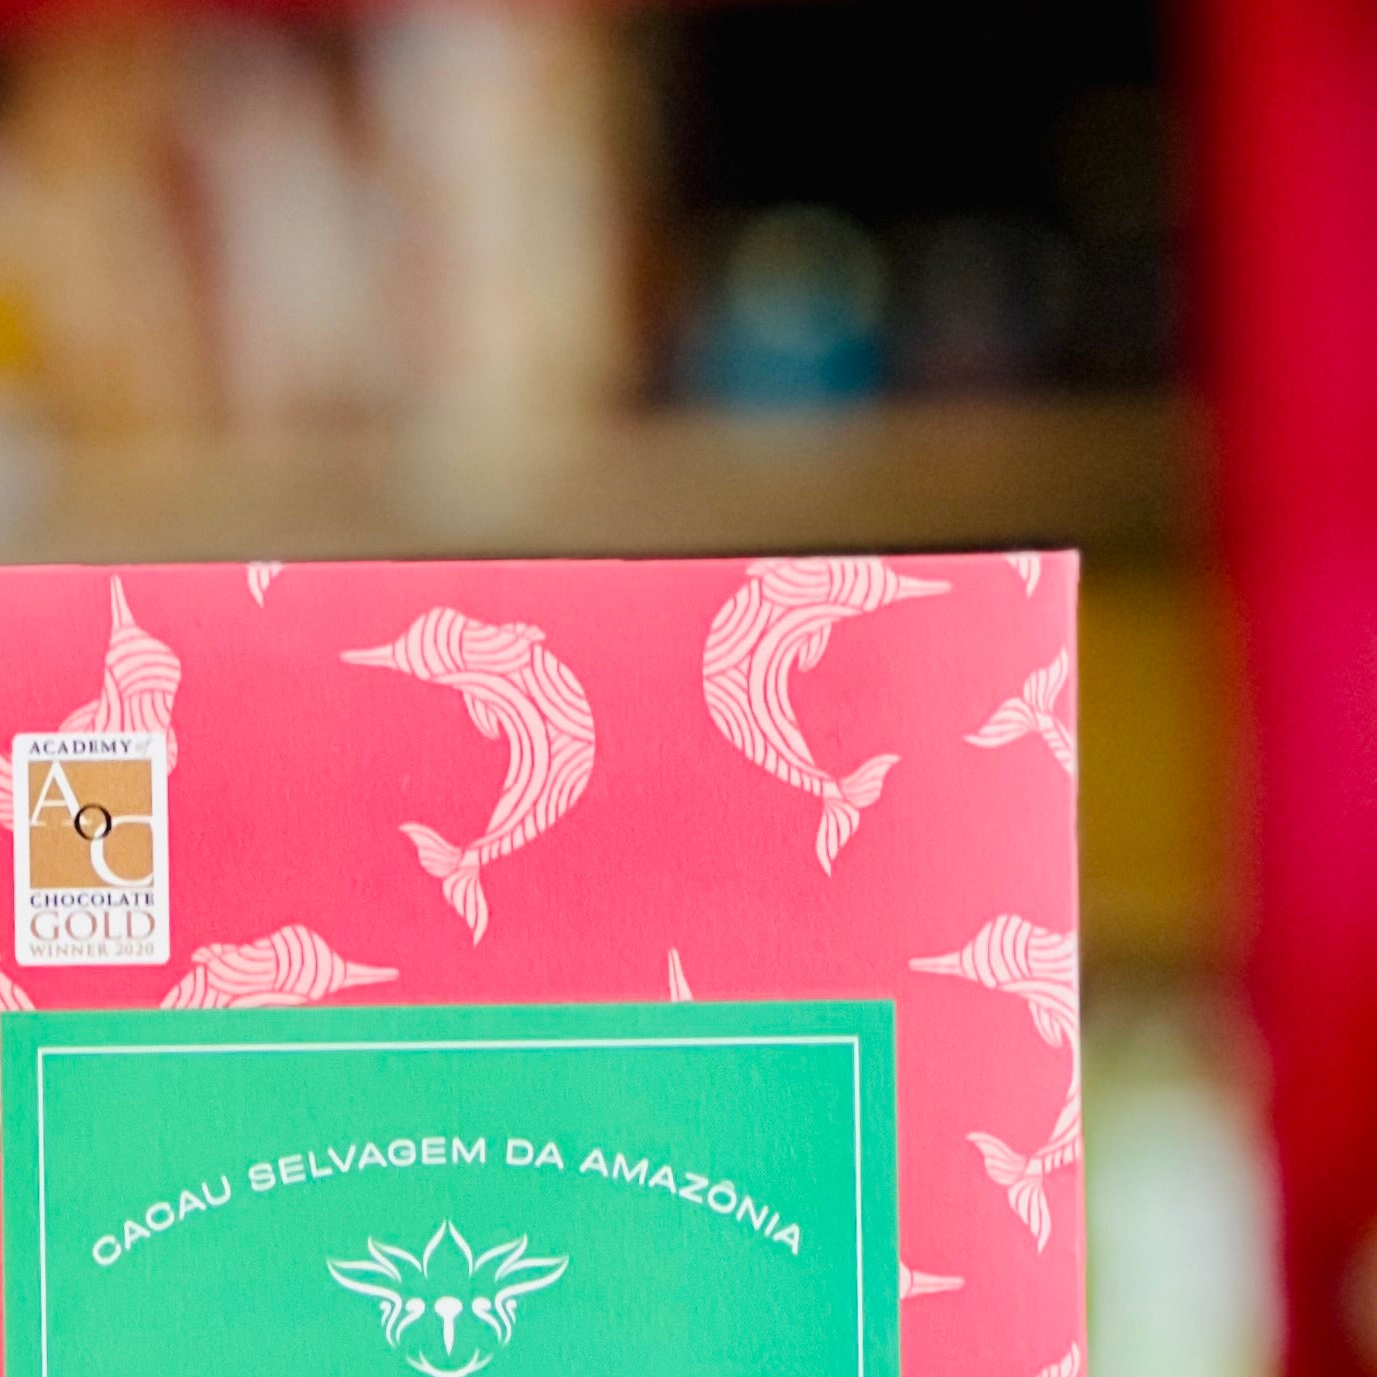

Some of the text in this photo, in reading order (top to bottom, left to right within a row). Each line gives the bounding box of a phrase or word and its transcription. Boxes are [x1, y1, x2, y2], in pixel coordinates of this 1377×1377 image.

[29, 739, 131, 755] ACADEMY
[30, 893, 154, 908] CHOCOLATE
[30, 911, 155, 941] GOLD
[29, 943, 154, 957] WINNER 2020
[91, 1136, 801, 1267] CACAU SELVAGEM DA AMAZÔNIA
